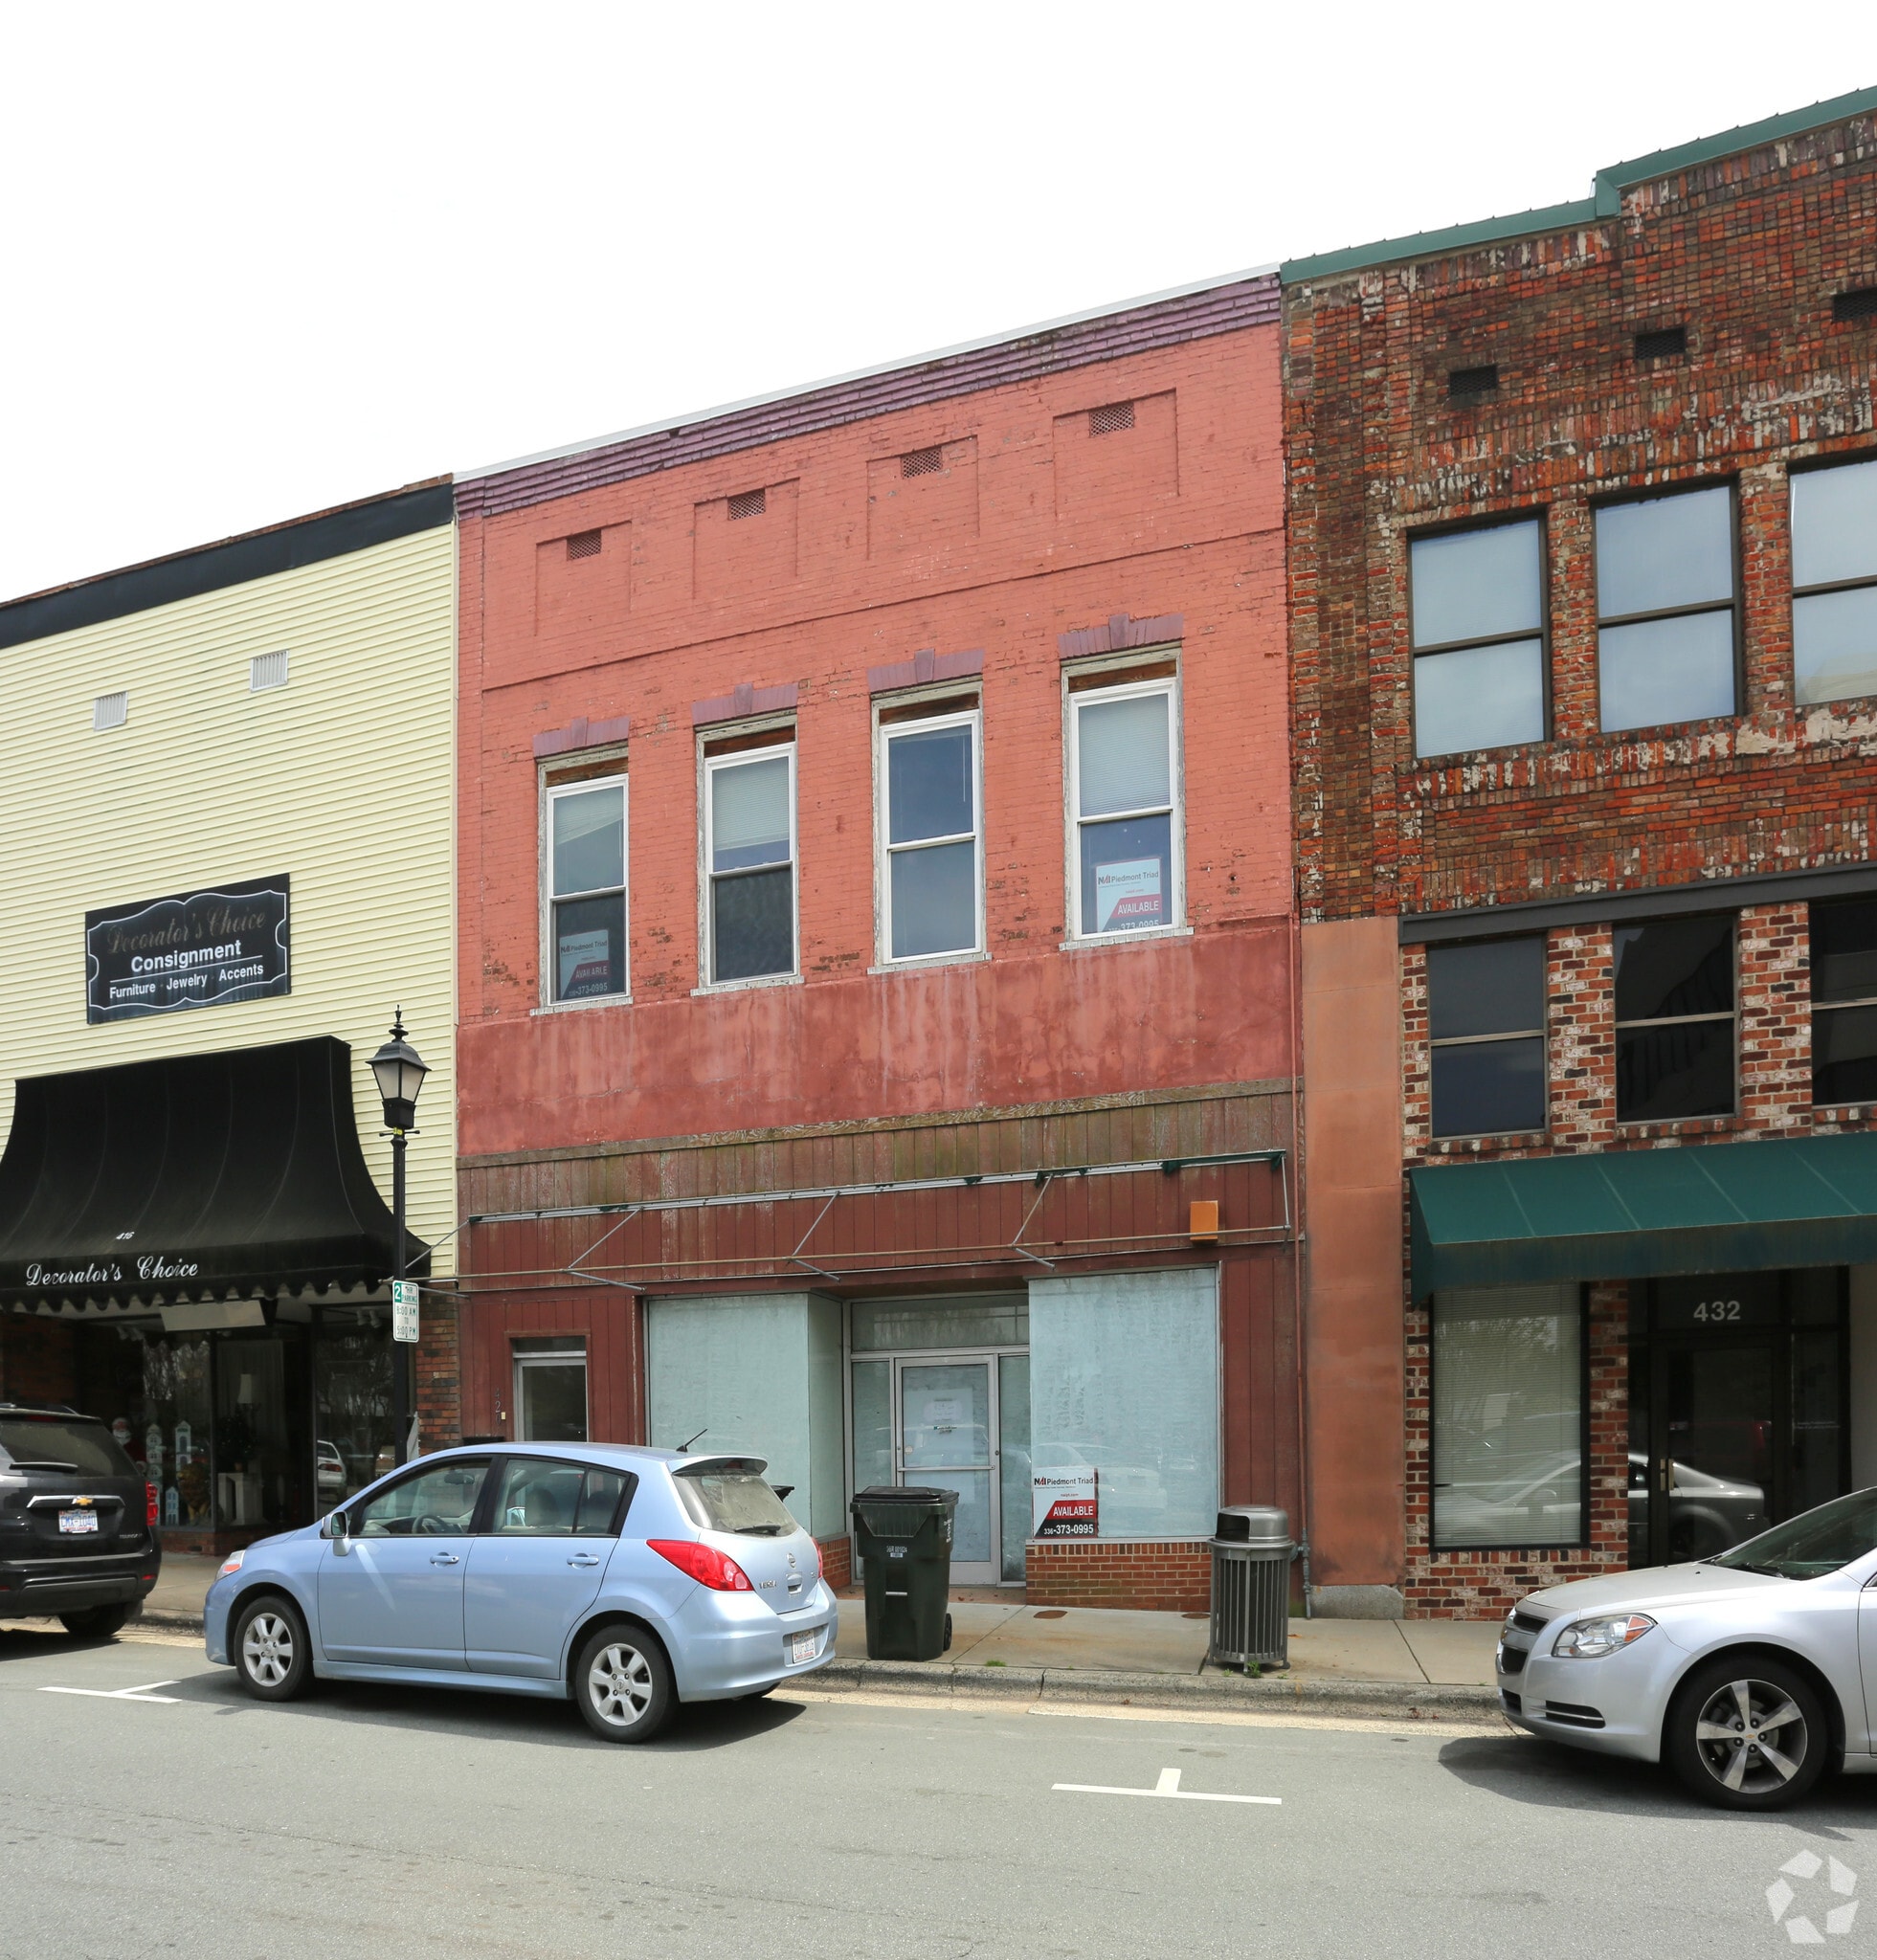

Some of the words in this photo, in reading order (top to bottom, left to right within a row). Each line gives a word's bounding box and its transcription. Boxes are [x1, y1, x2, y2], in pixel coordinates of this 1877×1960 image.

[1111, 873, 1141, 882] Piedmont
[1118, 901, 1159, 915] AVAILABLE
[108, 913, 203, 954] Decorator's
[207, 904, 266, 937] Choice
[571, 942, 593, 950] Piedmont
[131, 940, 241, 972] Consignment
[575, 966, 608, 978] AVAILABLE
[109, 982, 156, 999] Furniture
[167, 973, 208, 991] Jewelry
[219, 964, 264, 982] Accents
[26, 1263, 123, 1286] Decorator's
[137, 1256, 198, 1280] Choice
[394, 1285, 401, 1300] 2
[409, 1307, 416, 1316] AM
[1693, 1301, 1741, 1322] 432
[409, 1326, 416, 1336] PM
[1053, 1505, 1093, 1517] AVAILABLE
[1043, 1524, 1094, 1536] 336-373-0995
